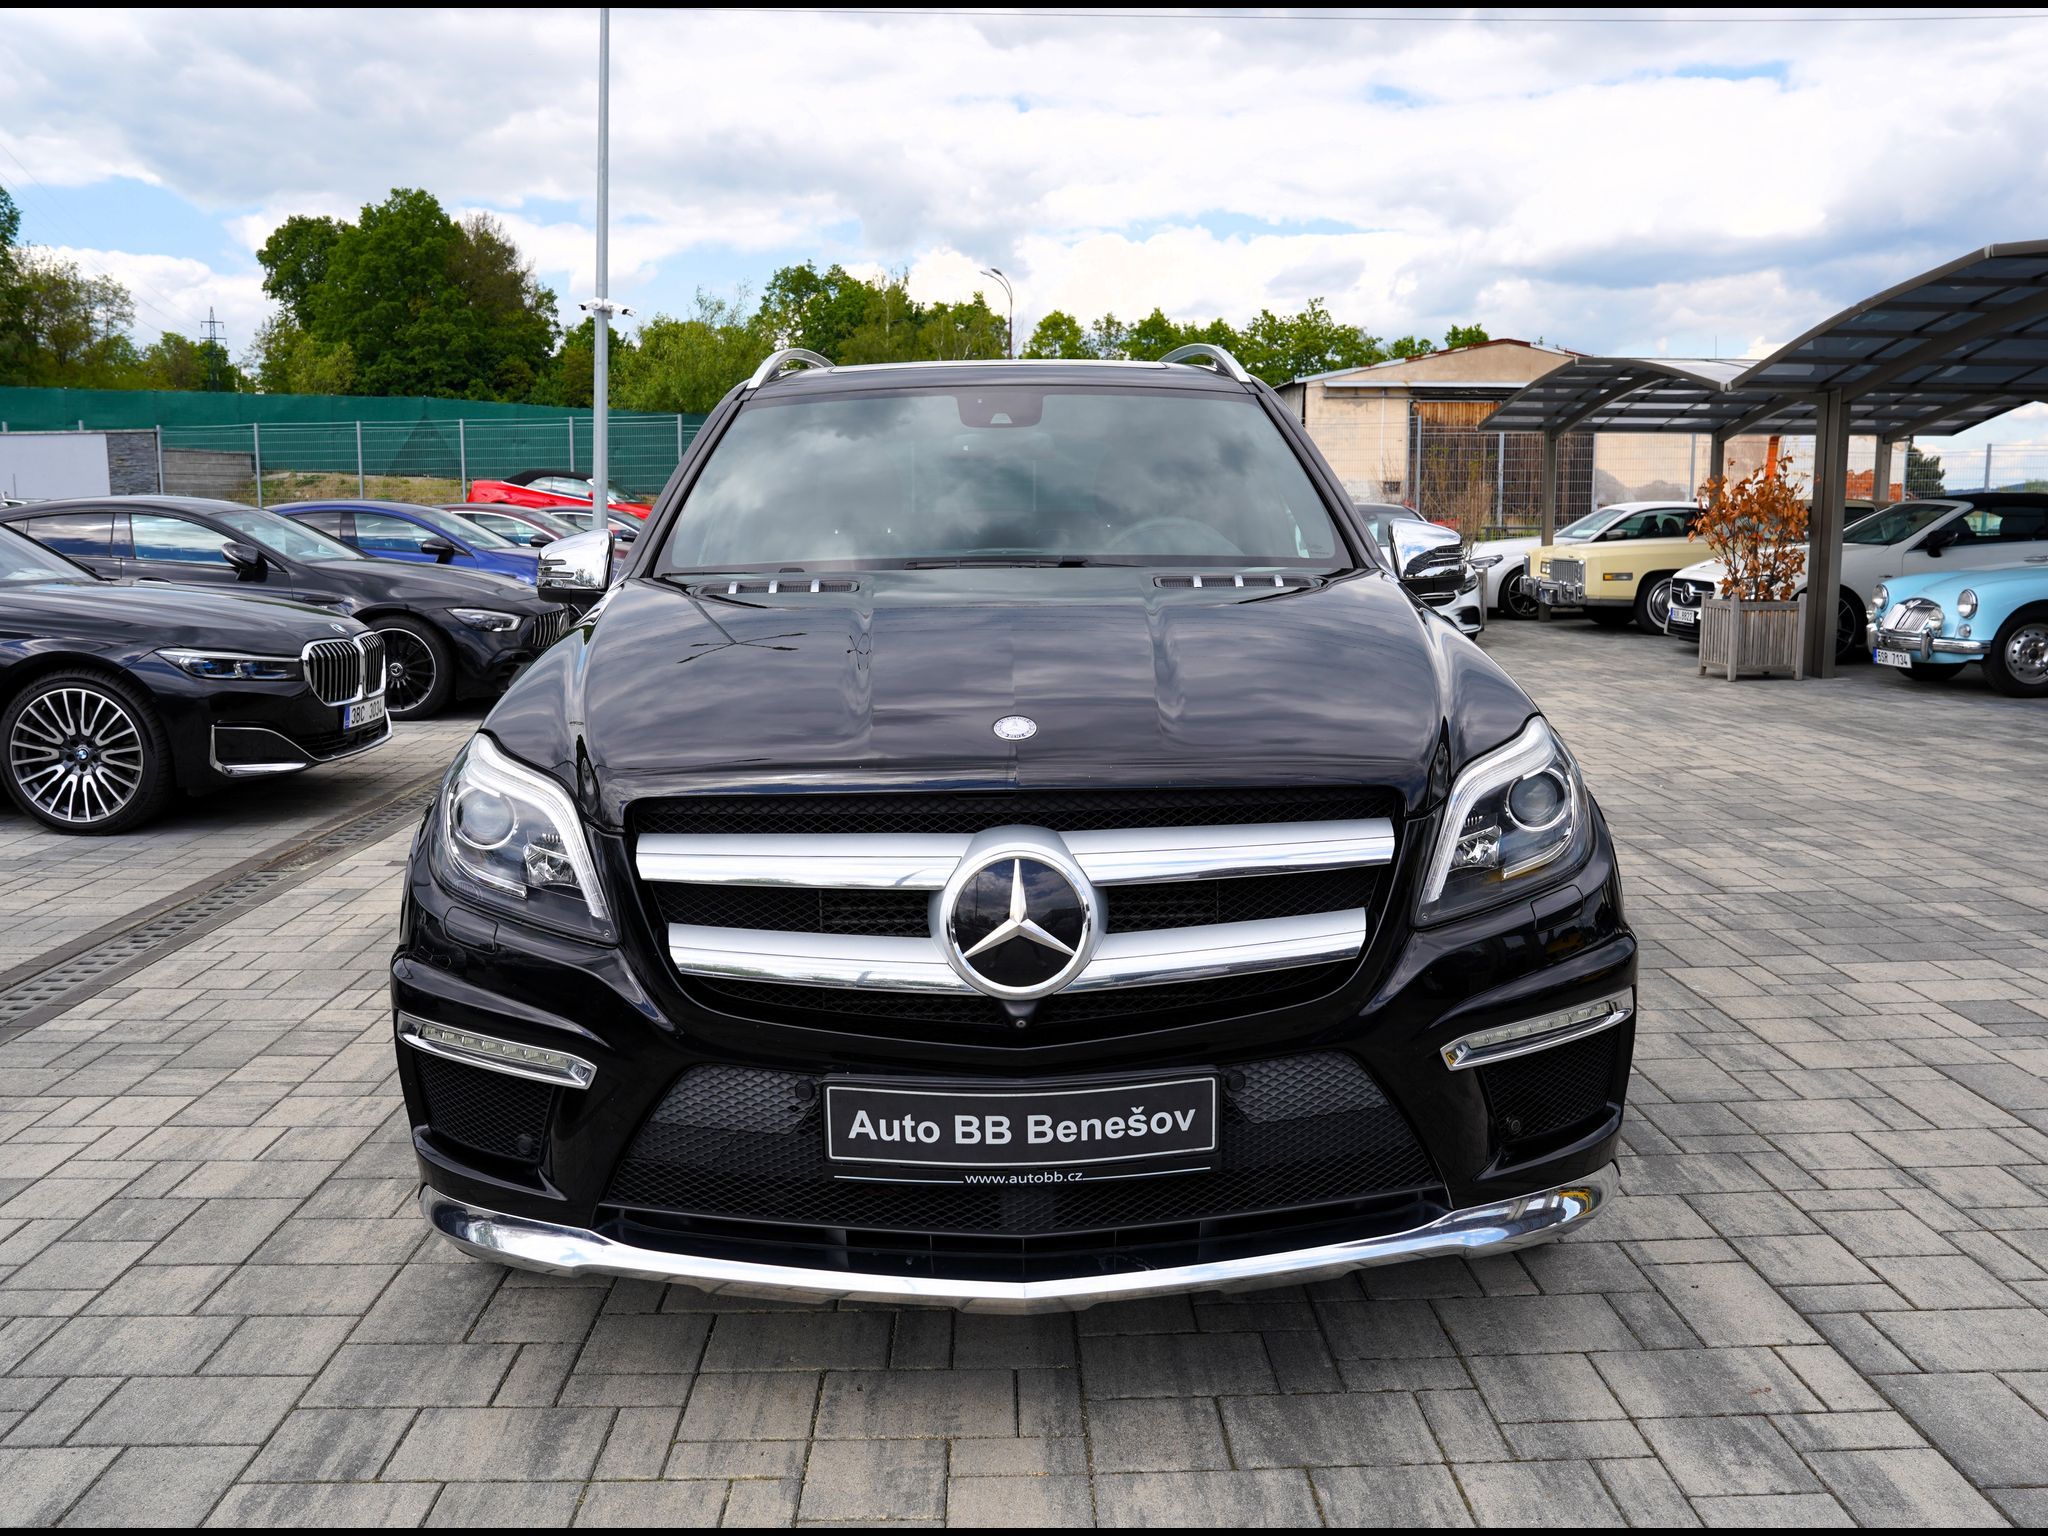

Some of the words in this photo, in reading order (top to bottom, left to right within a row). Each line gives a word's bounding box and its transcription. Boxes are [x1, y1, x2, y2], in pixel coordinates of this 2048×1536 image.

[1892, 653, 1908, 666] 7134
[351, 705, 365, 724] 3BC
[369, 699, 382, 719] 3034
[848, 1110, 941, 1144] Auto
[954, 1114, 1012, 1145] BB
[1027, 1106, 1196, 1144] Benešov
[965, 1171, 1083, 1184] www.autobb.cz
